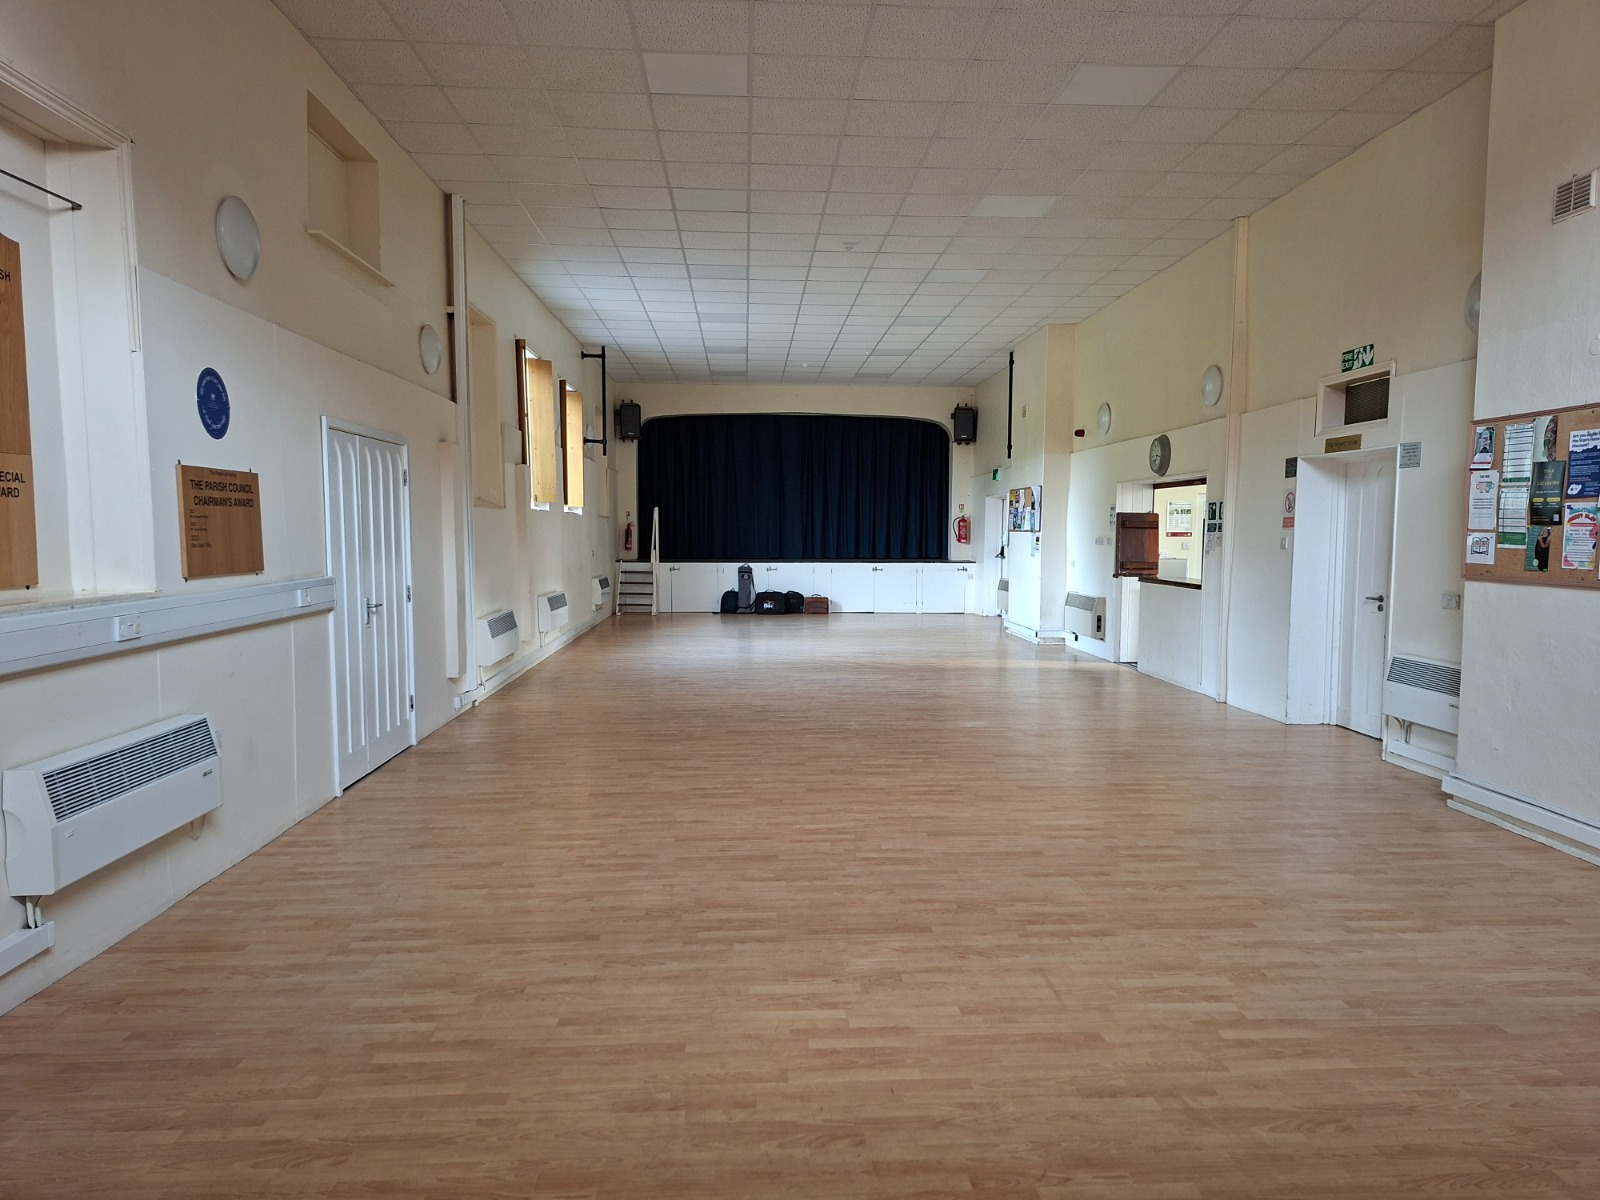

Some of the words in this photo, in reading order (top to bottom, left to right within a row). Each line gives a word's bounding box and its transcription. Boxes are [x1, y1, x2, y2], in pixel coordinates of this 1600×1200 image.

[1342, 352, 1354, 361] FIRE
[1342, 361, 1353, 370] EXIT
[0, 486, 20, 498] ARD
[190, 479, 204, 491] THE
[205, 480, 228, 492] PARISH
[229, 483, 254, 494] COUNCIL
[193, 495, 233, 508] CHAIRMAN'S
[234, 498, 254, 508] AWARD
